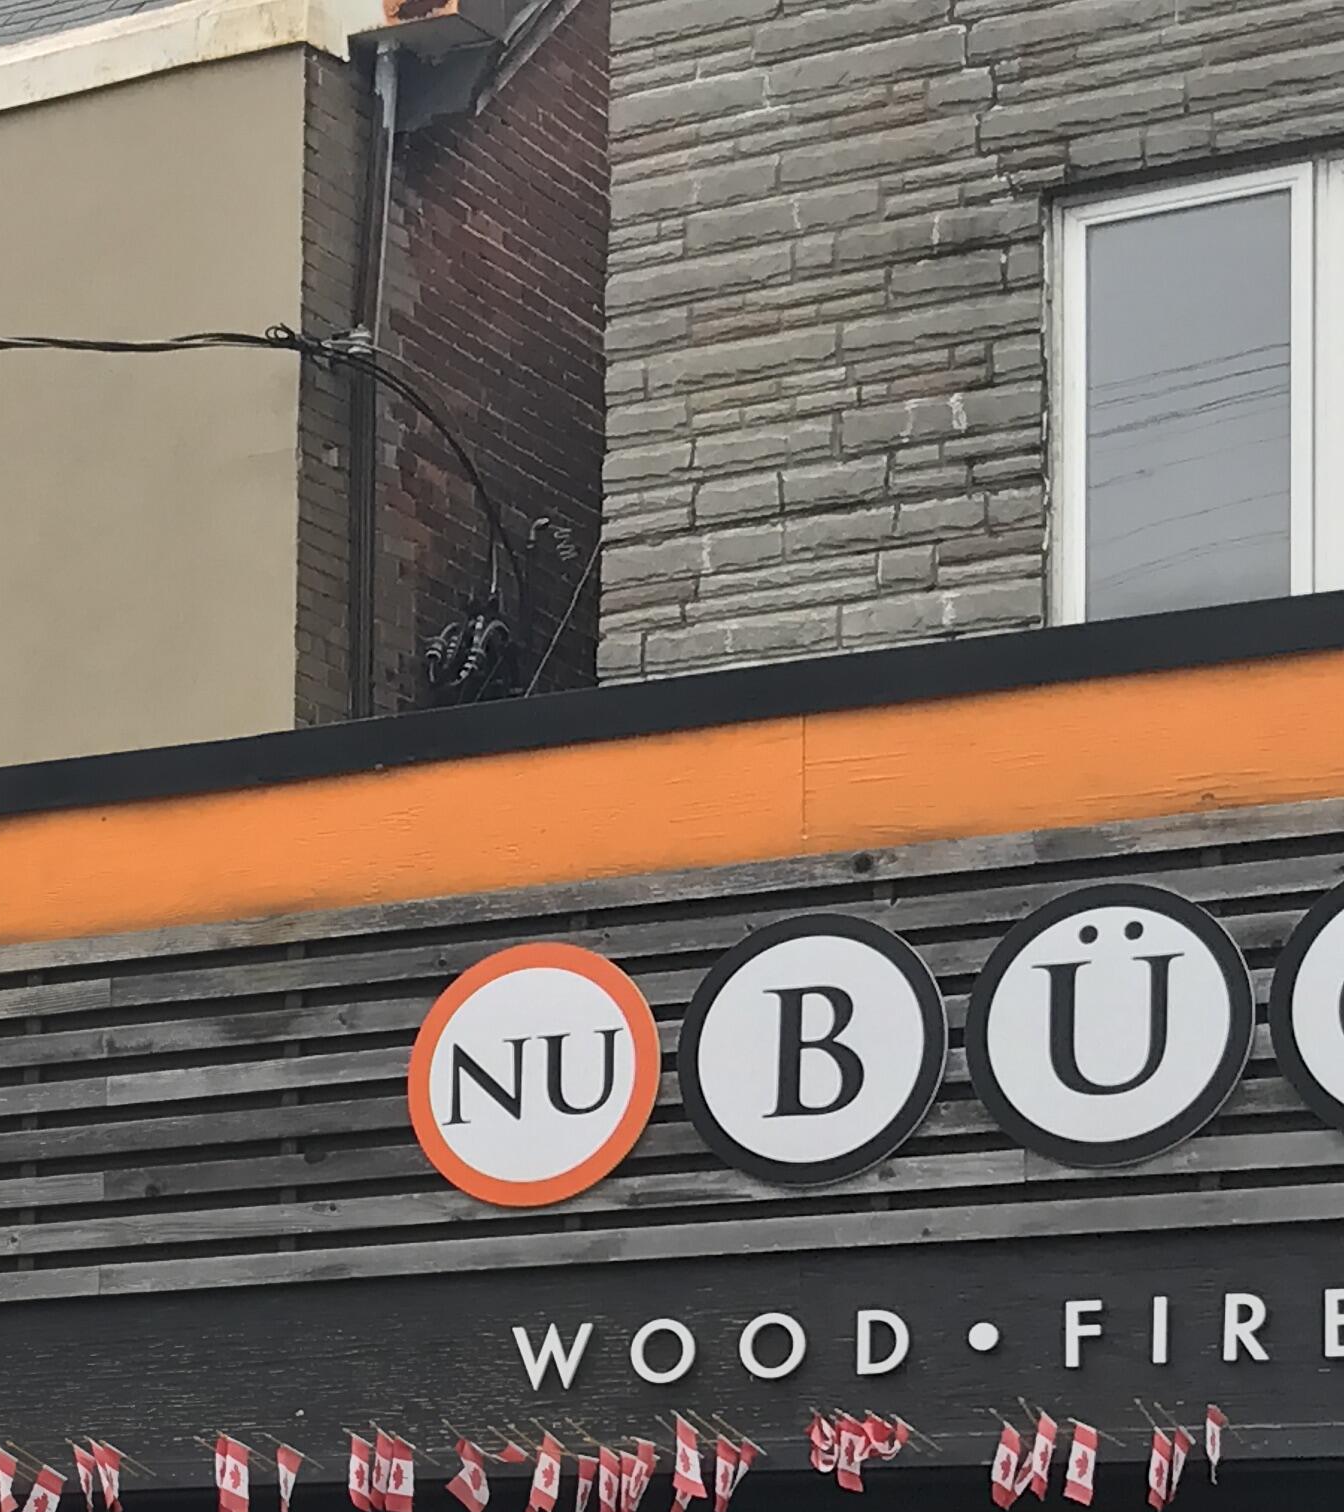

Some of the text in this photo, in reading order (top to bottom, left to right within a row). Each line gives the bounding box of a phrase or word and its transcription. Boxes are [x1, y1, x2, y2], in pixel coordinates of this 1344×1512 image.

[442, 1028, 625, 1127] NU
[512, 1287, 1344, 1392] WOOD FIRE
